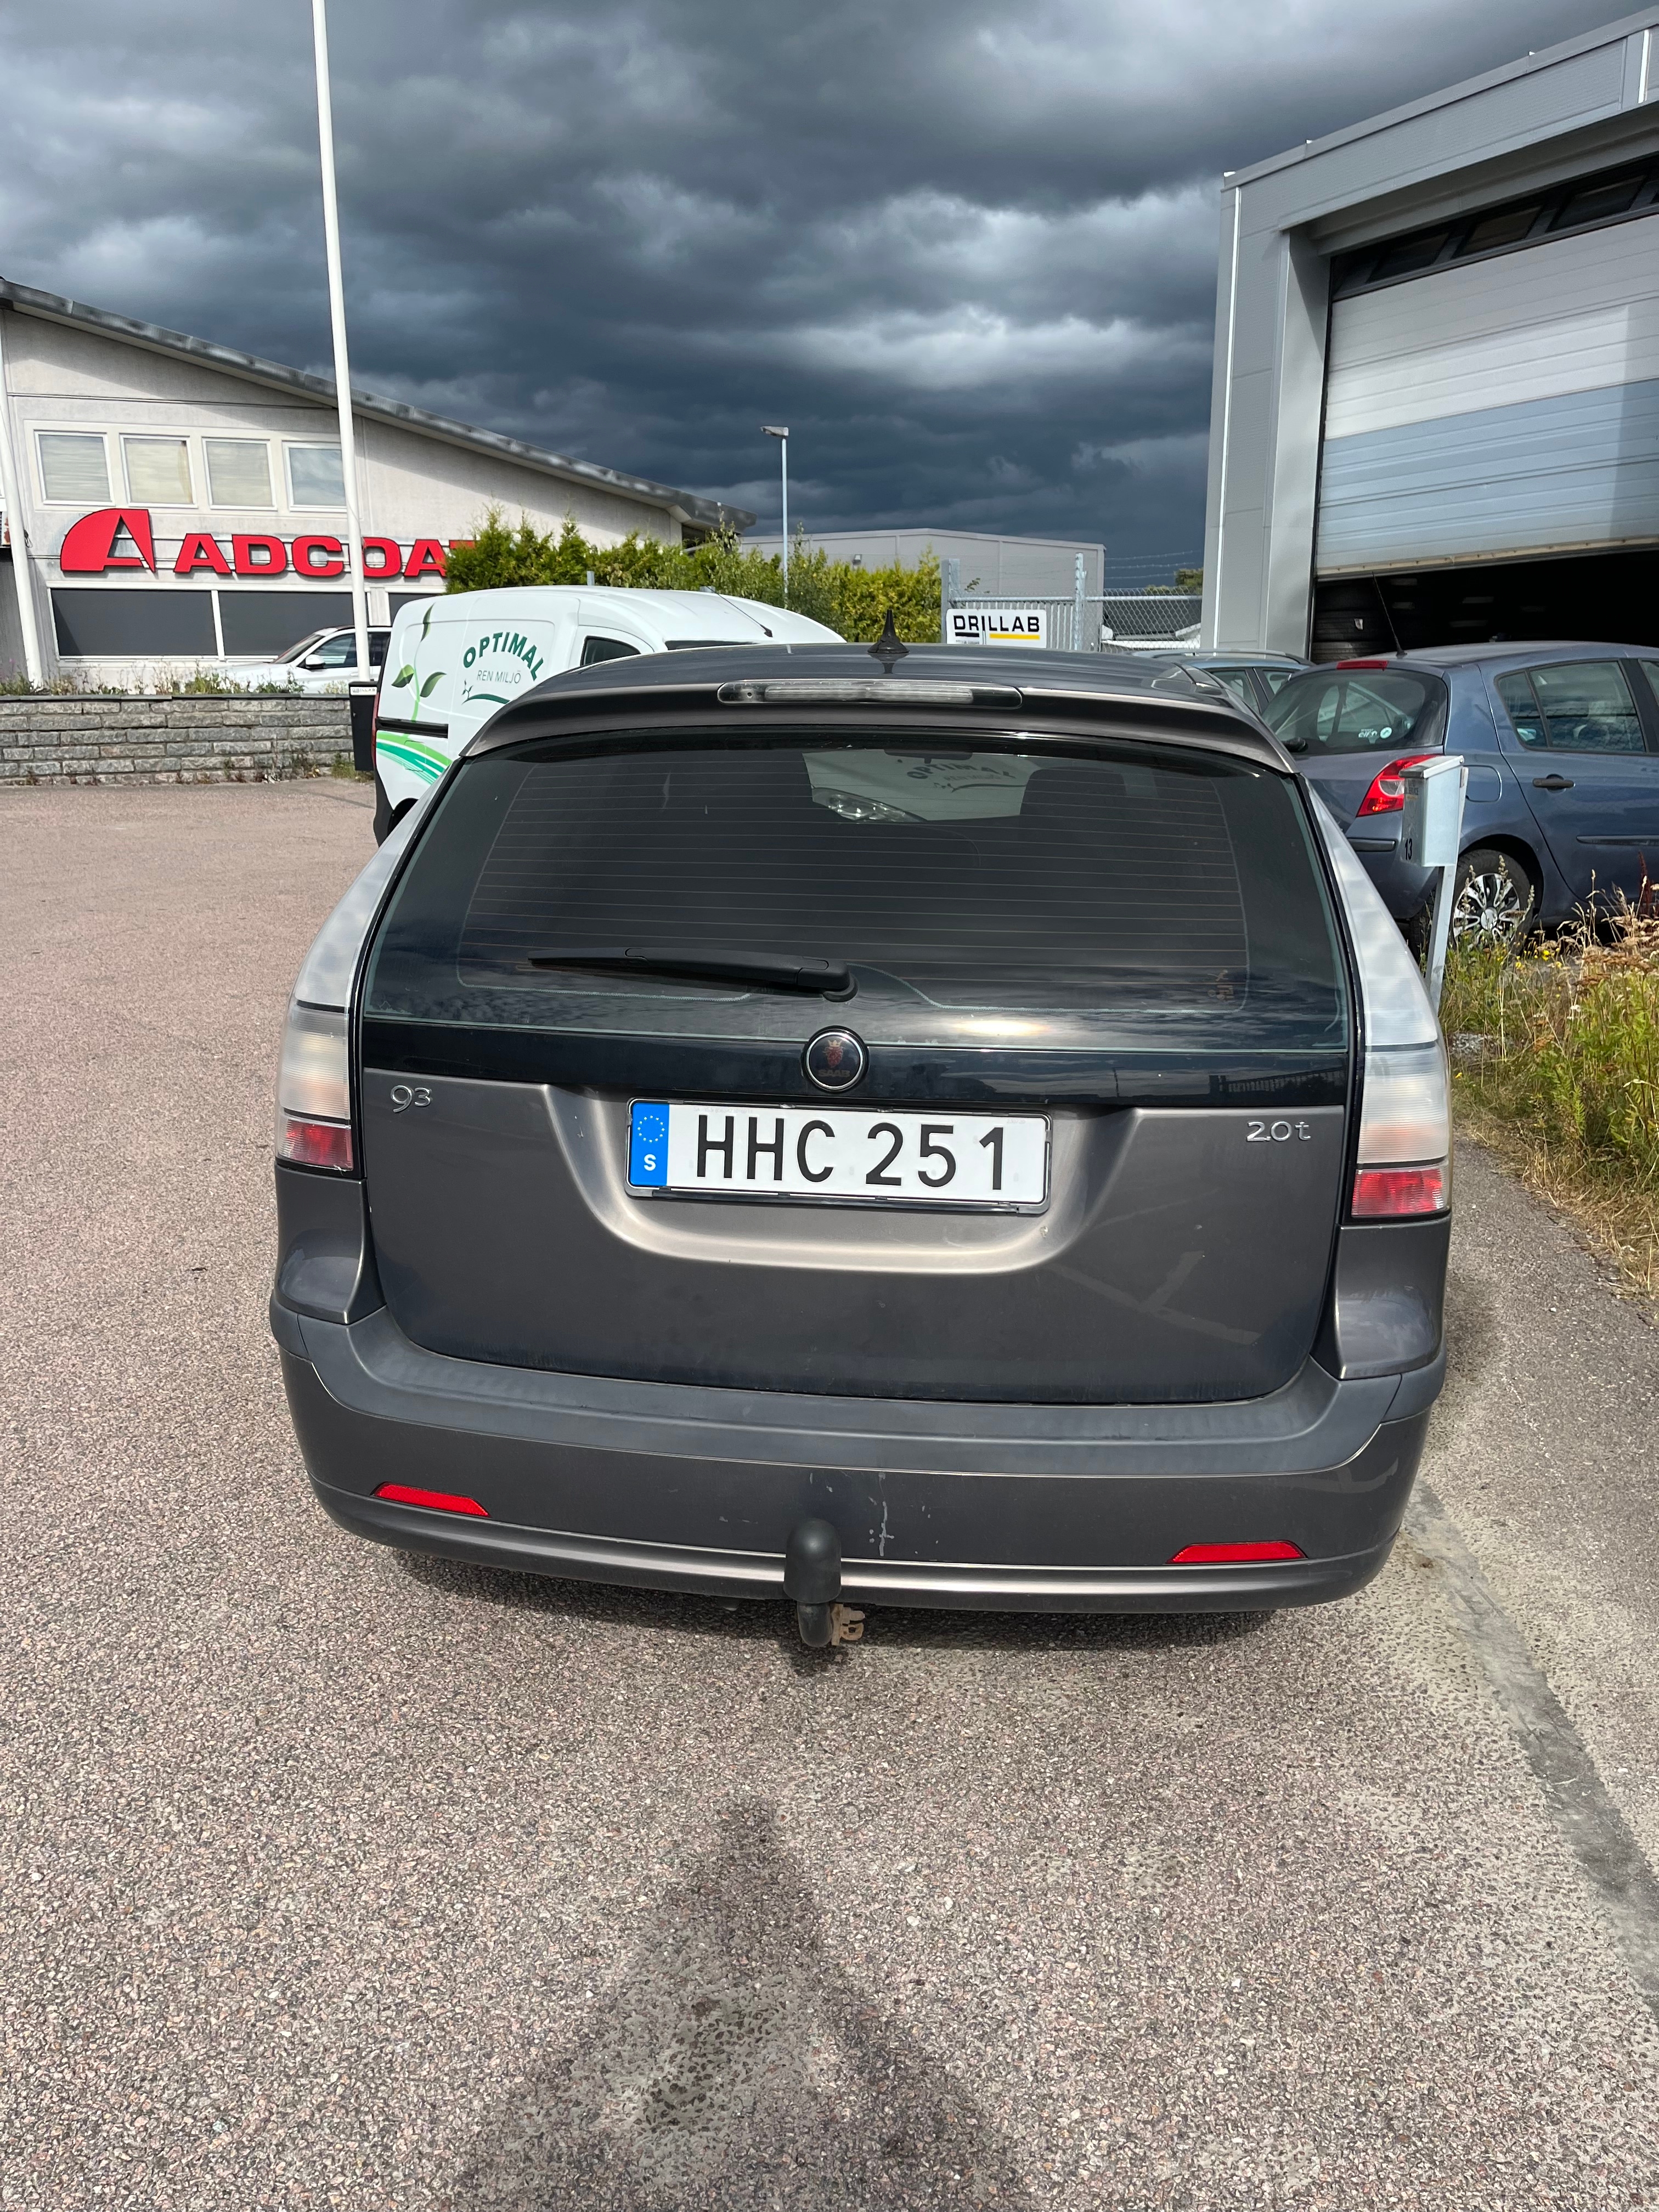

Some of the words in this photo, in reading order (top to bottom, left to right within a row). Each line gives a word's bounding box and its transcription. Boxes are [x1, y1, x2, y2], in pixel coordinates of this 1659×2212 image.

[173, 533, 476, 578] ADCOA
[953, 615, 1040, 632] DRILLAB
[463, 631, 544, 681] OPTIMAL
[477, 669, 493, 682] REN
[495, 670, 522, 684] MILJÖ
[1405, 838, 1413, 860] 13
[818, 1069, 850, 1077] SAAB
[697, 1114, 835, 1183] HHC
[865, 1121, 1004, 1190] 251
[644, 1153, 656, 1172] S
